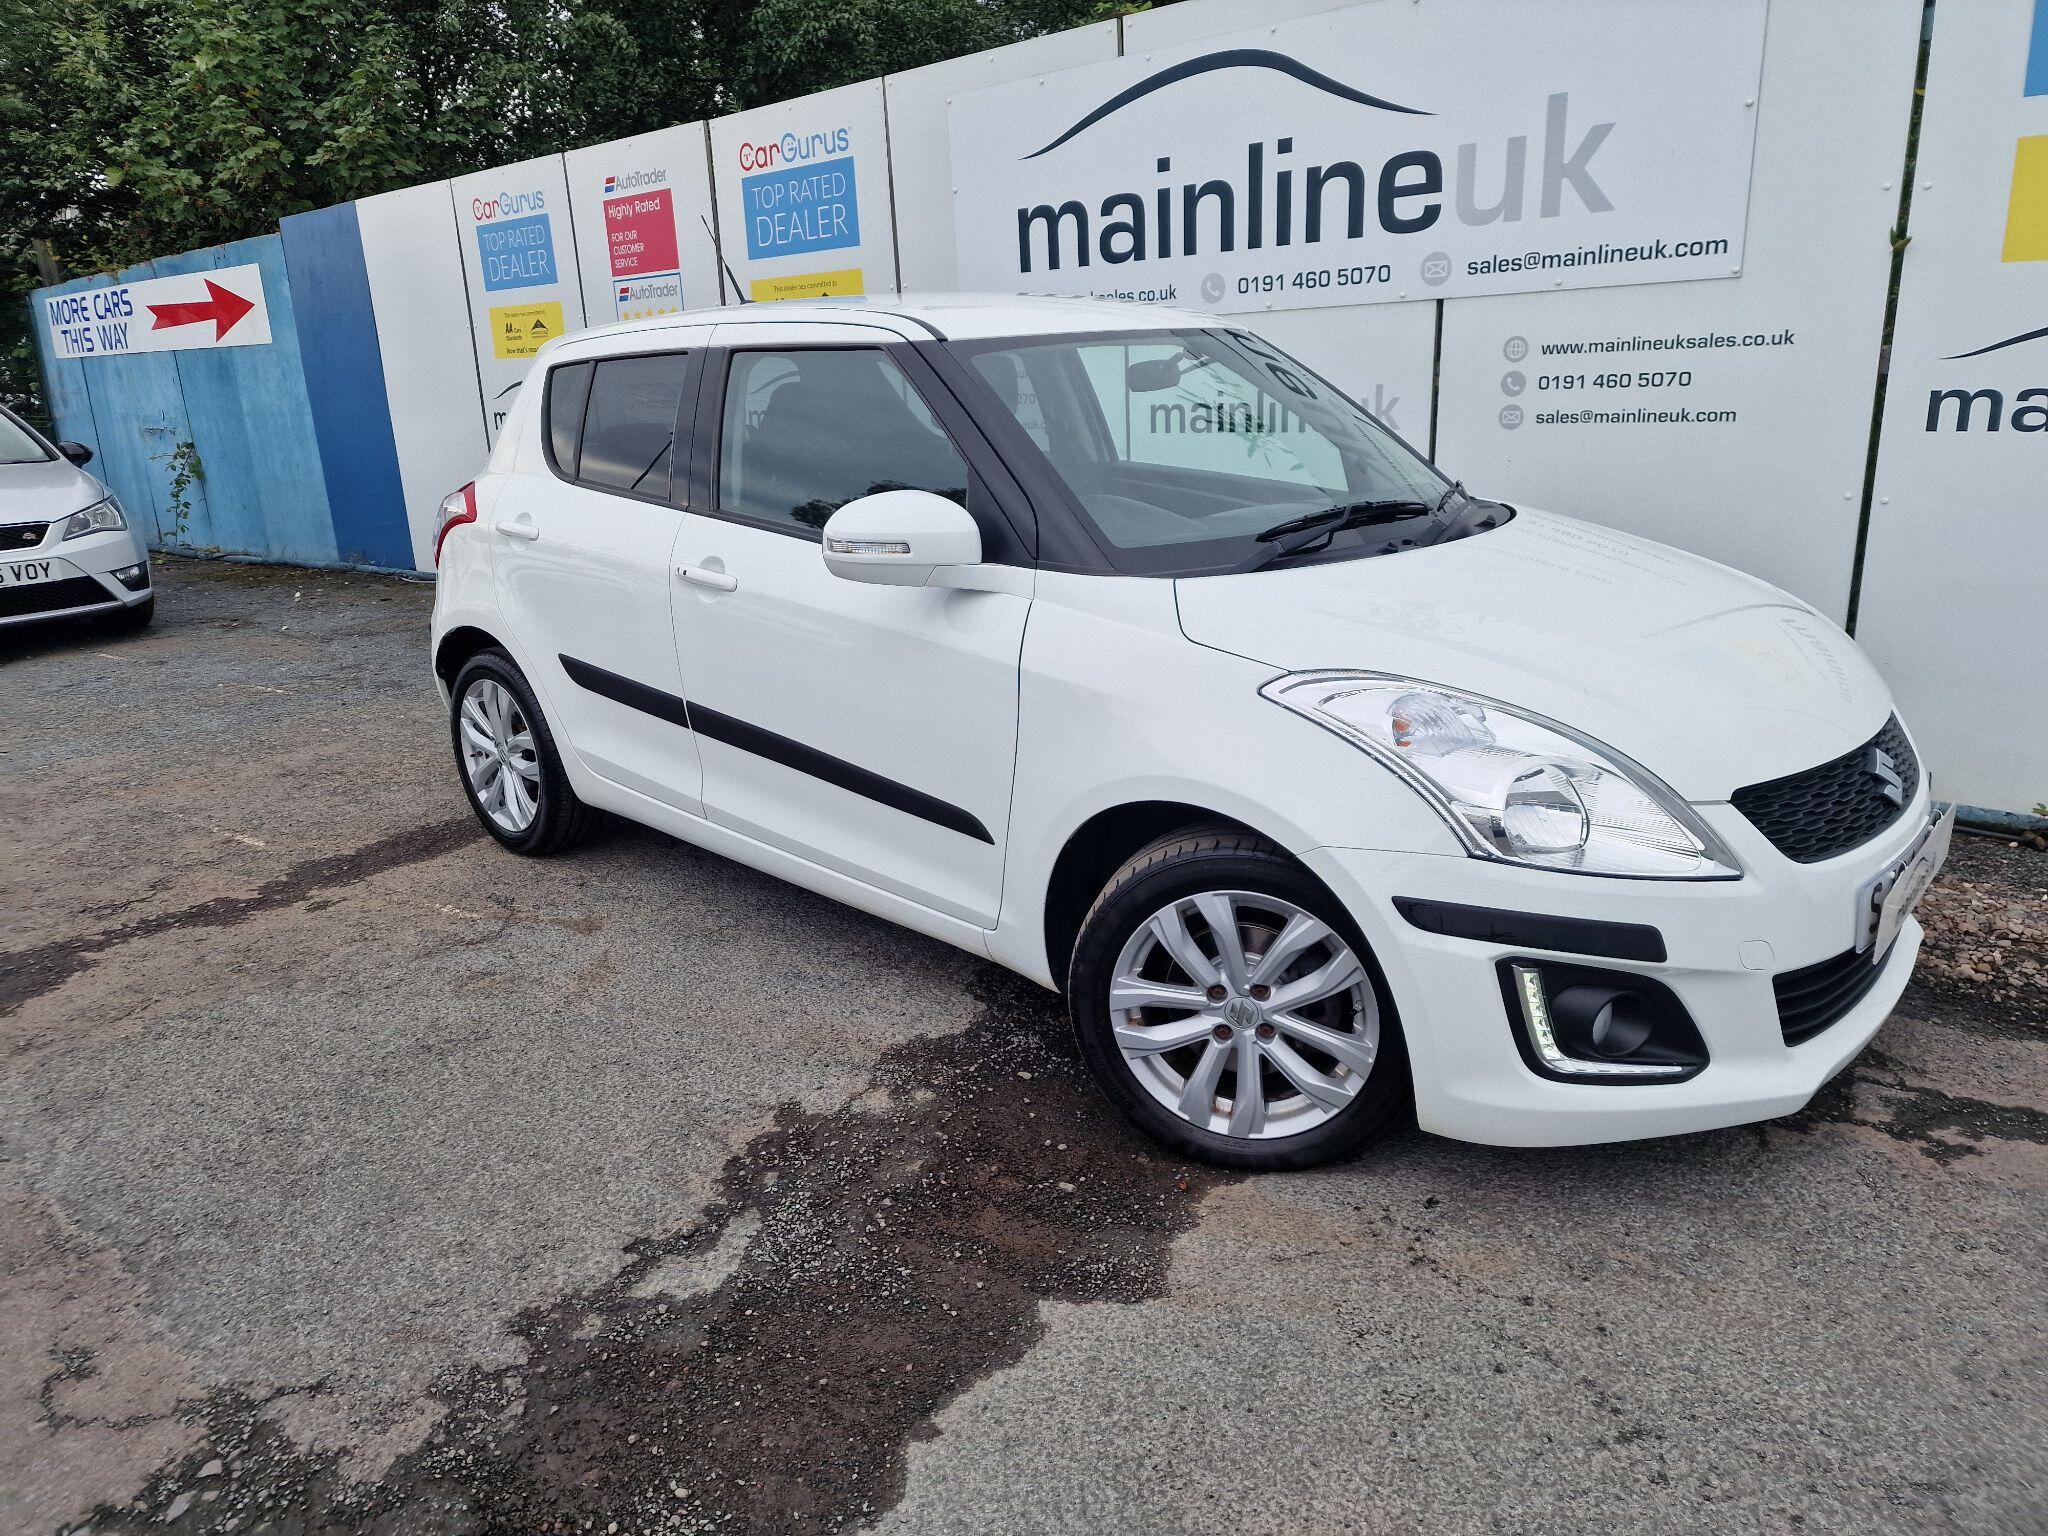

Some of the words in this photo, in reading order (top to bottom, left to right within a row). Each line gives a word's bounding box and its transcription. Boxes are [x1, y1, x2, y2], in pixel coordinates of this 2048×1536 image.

[739, 127, 849, 171] CarGurus
[615, 168, 666, 191] AutoTrader
[751, 183, 784, 210] TOP
[789, 172, 846, 204] RATED
[1017, 91, 1616, 274] mainlineuk
[472, 190, 545, 221] CarGurus
[608, 203, 633, 219] Highly
[635, 197, 660, 214] Rated
[482, 231, 505, 252] TOP
[507, 224, 546, 248] RATED
[611, 232, 624, 243] FOR
[625, 230, 638, 240] OUR
[756, 203, 849, 247] DEALER
[613, 242, 645, 255] CUSTOMER
[488, 249, 551, 282] DEALER
[615, 257, 638, 269] SERVICE
[1237, 273, 1285, 295] 0191
[1292, 269, 1331, 290] 460
[1337, 264, 1392, 287] 5070
[1467, 237, 1728, 276] sales@mainlineuk.com
[630, 284, 678, 301] AutoTrader
[49, 296, 91, 326] MORE
[93, 288, 134, 320] CARS
[61, 327, 95, 354] THIS
[96, 322, 129, 351] WAY
[1541, 329, 1796, 355] www.mainlineuksales.co.uk
[1538, 374, 1586, 390] 0191
[1592, 373, 1632, 389] 460
[1638, 371, 1692, 387] 5070
[1535, 407, 1737, 424] sales@mainlineuk.com
[10, 561, 51, 582] VOY
